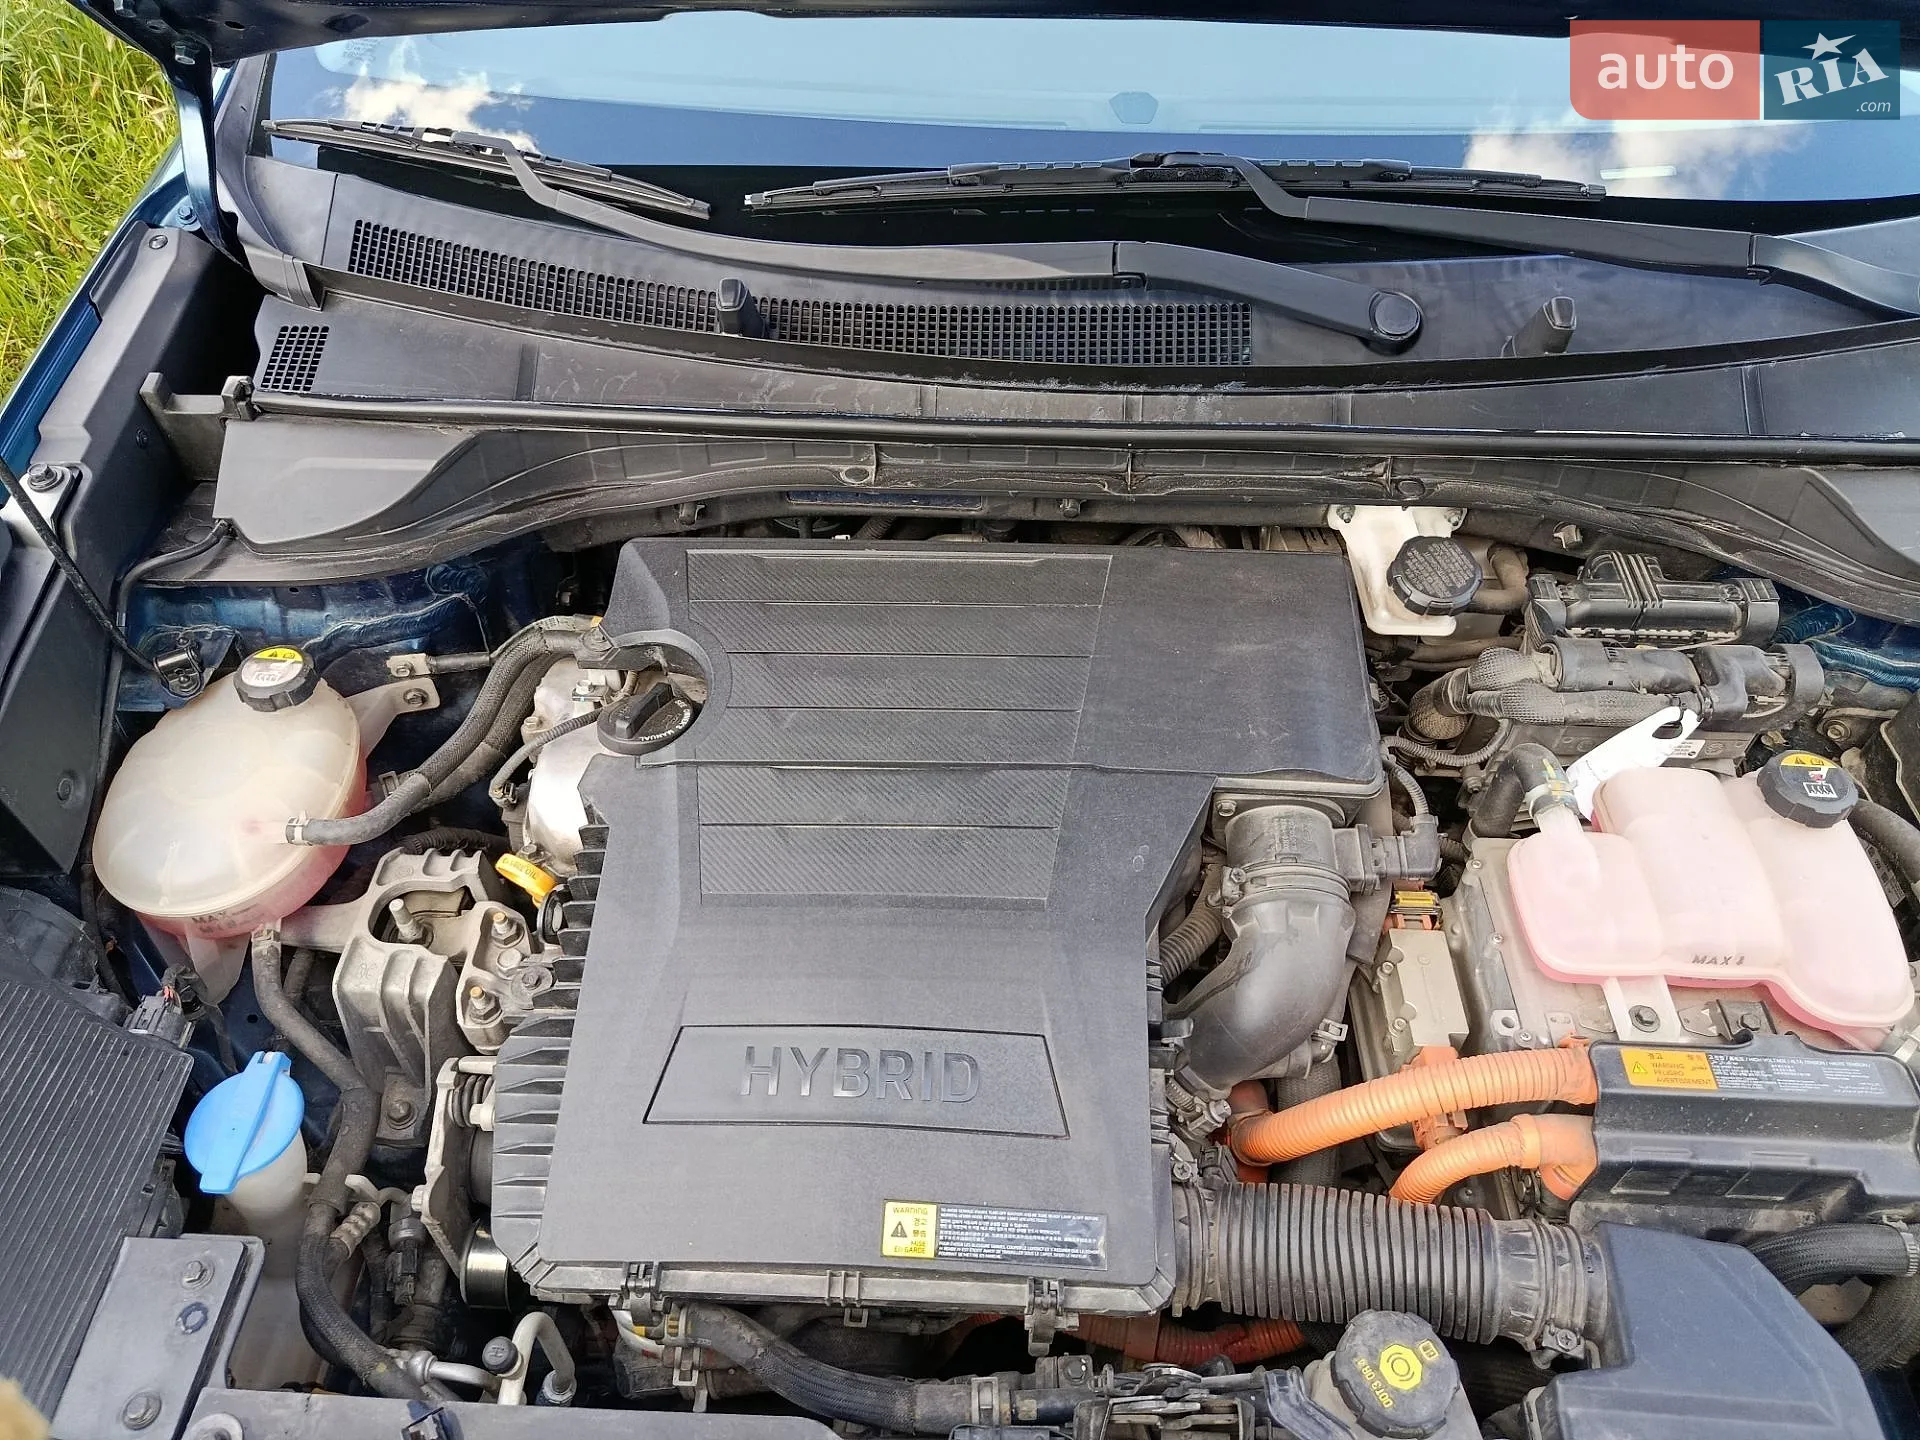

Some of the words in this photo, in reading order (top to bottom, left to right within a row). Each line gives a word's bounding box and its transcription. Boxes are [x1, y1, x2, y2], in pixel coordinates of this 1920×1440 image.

[639, 729, 675, 742] MANUAL
[525, 867, 537, 881] OIL
[1691, 953, 1732, 966] MAX
[739, 1045, 981, 1103] HYBRID
[892, 1207, 928, 1215] WARNING
[904, 1246, 926, 1254] GARDE
